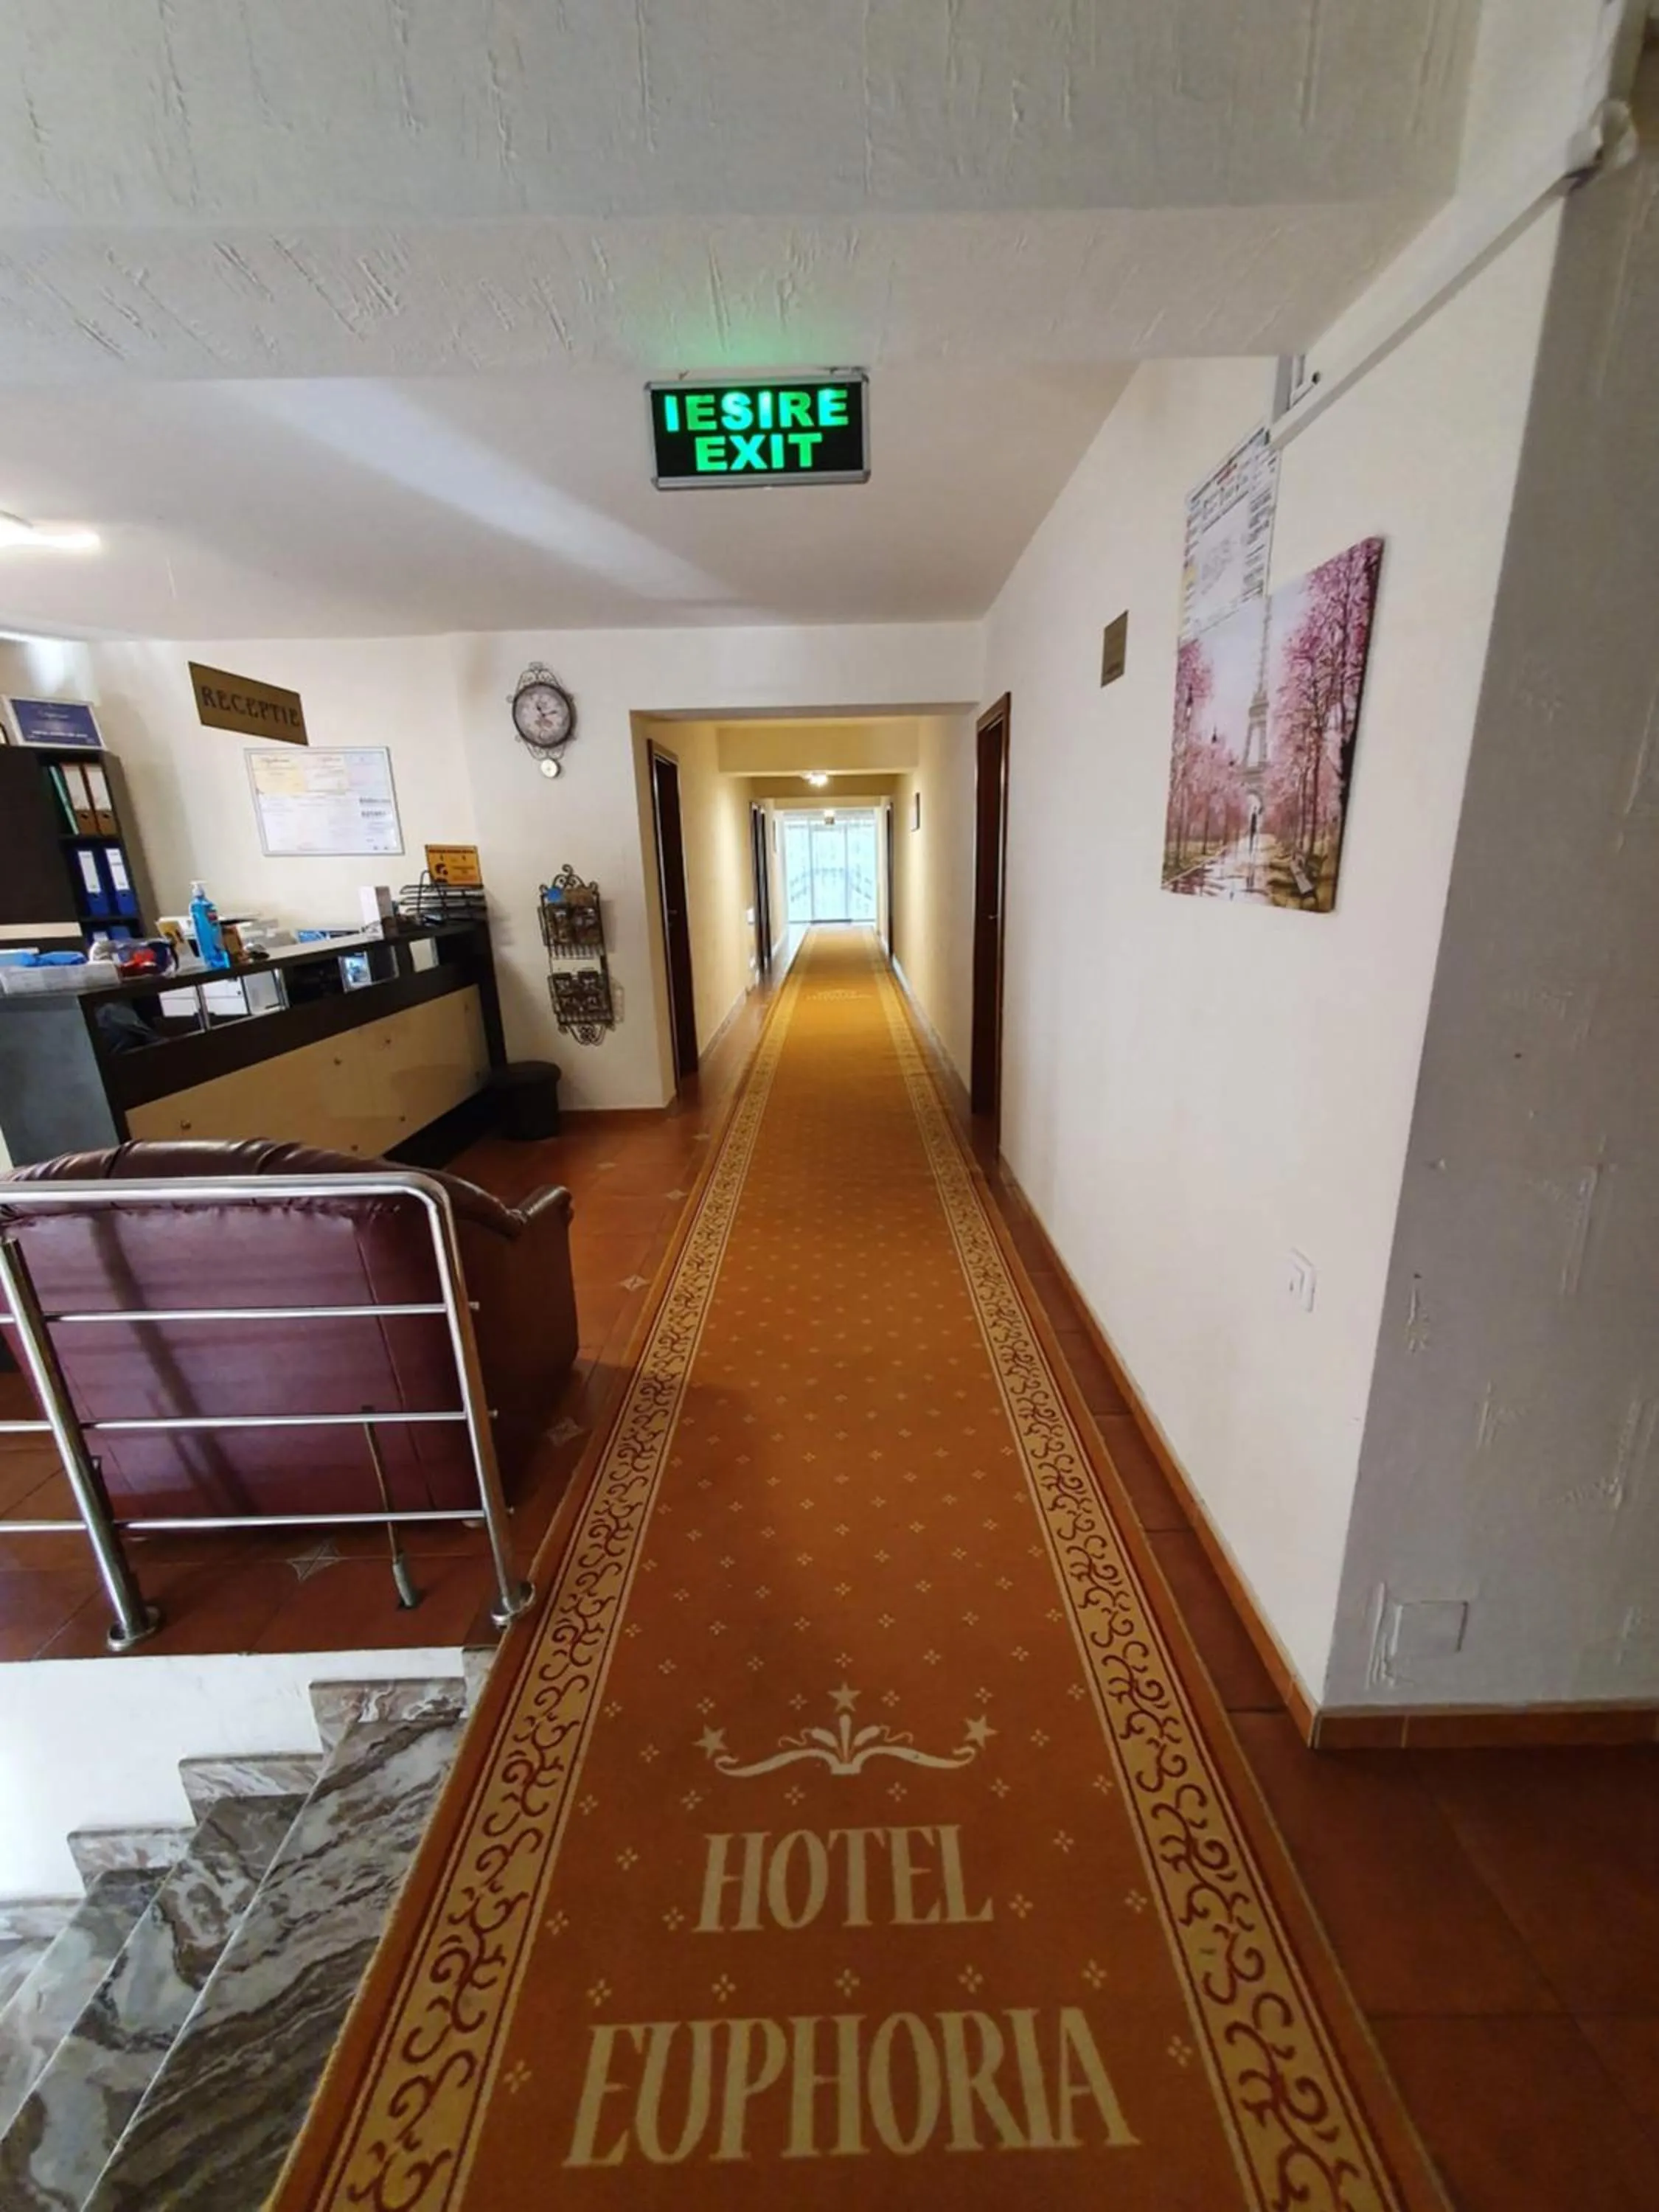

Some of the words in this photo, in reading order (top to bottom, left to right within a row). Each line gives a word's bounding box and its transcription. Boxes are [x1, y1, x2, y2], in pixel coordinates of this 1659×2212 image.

[664, 389, 849, 432] IESIRE
[695, 433, 823, 472] EXIT
[201, 686, 300, 727] RECEPTIE
[692, 1823, 994, 1933] HOTEL
[562, 2006, 1143, 2168] EUPHORIA
